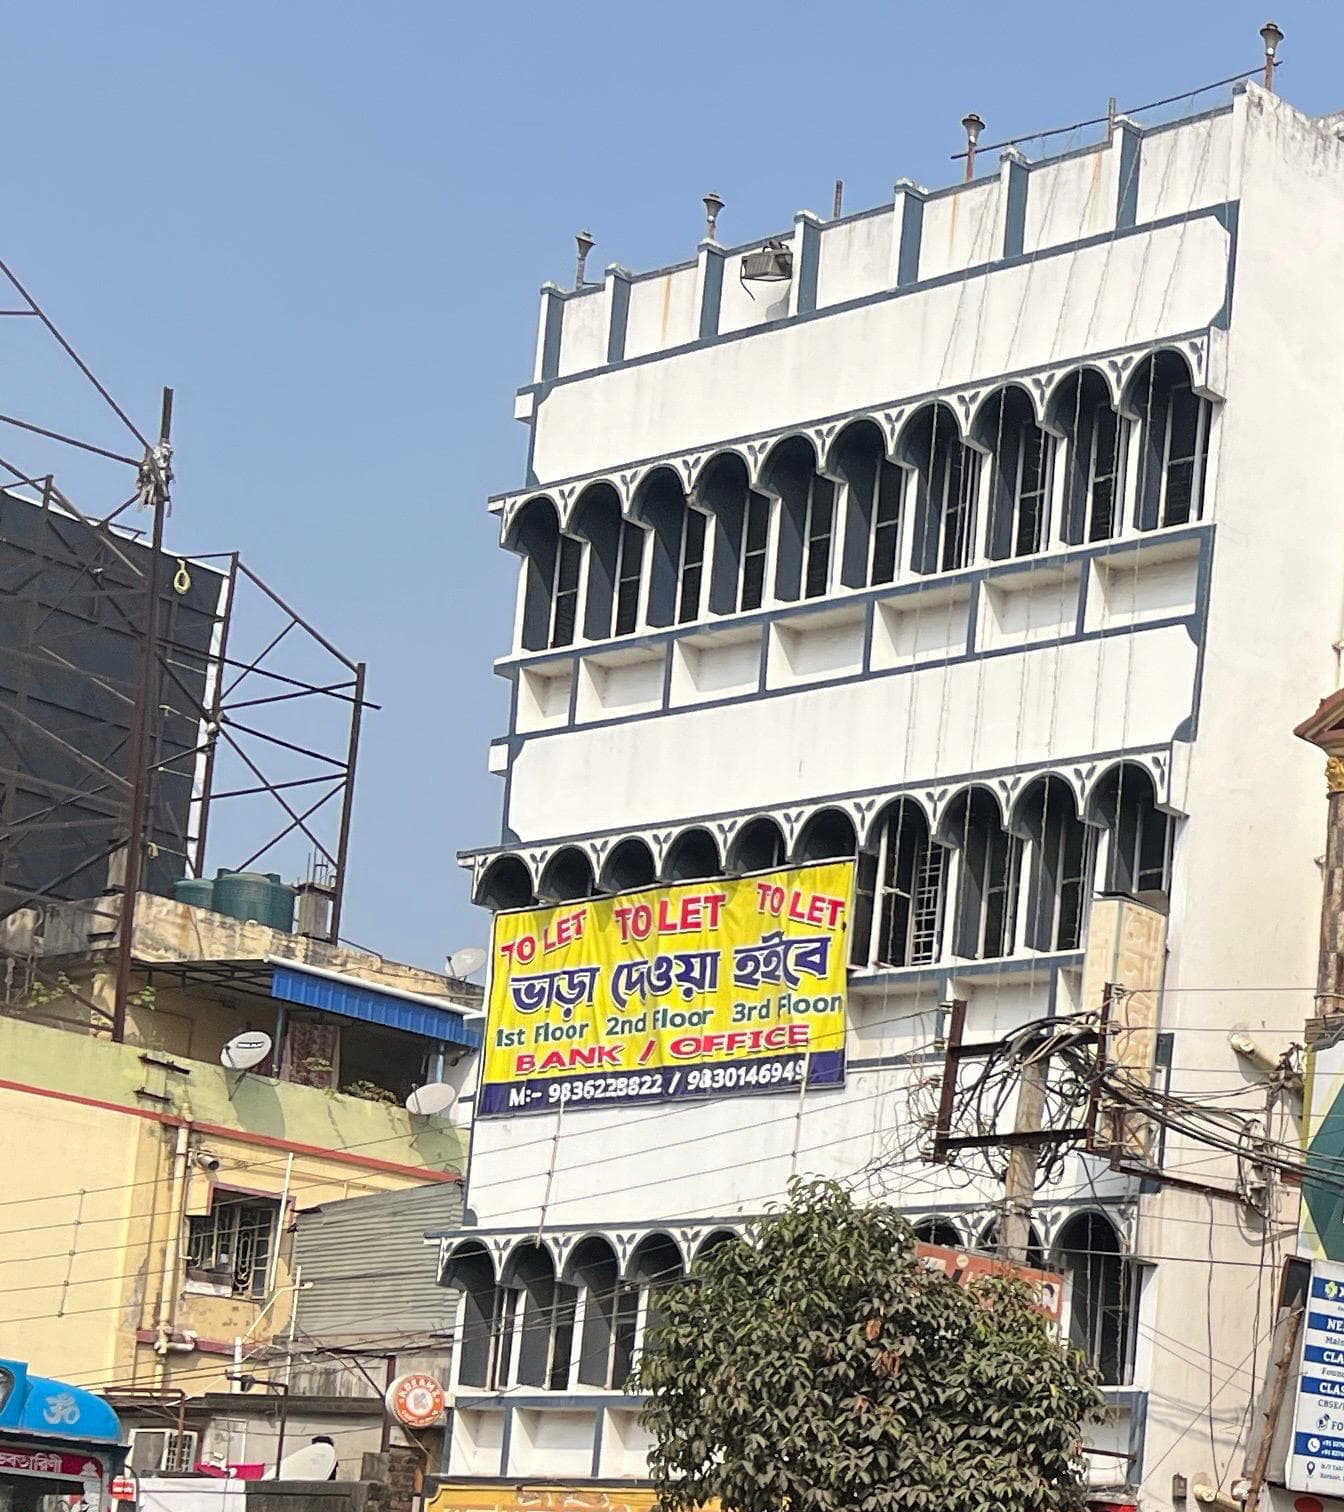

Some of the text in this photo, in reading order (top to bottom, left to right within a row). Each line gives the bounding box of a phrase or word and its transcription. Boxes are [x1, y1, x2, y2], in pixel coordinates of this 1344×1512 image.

[501, 882, 846, 965] TO LET TO LET TO LET
[510, 931, 831, 1021] ভাড়া দেওয়া হইবে
[497, 999, 771, 1047] 1st Floor 2nd Floor 3rd
[515, 1024, 810, 1073] BANK OFFICE
